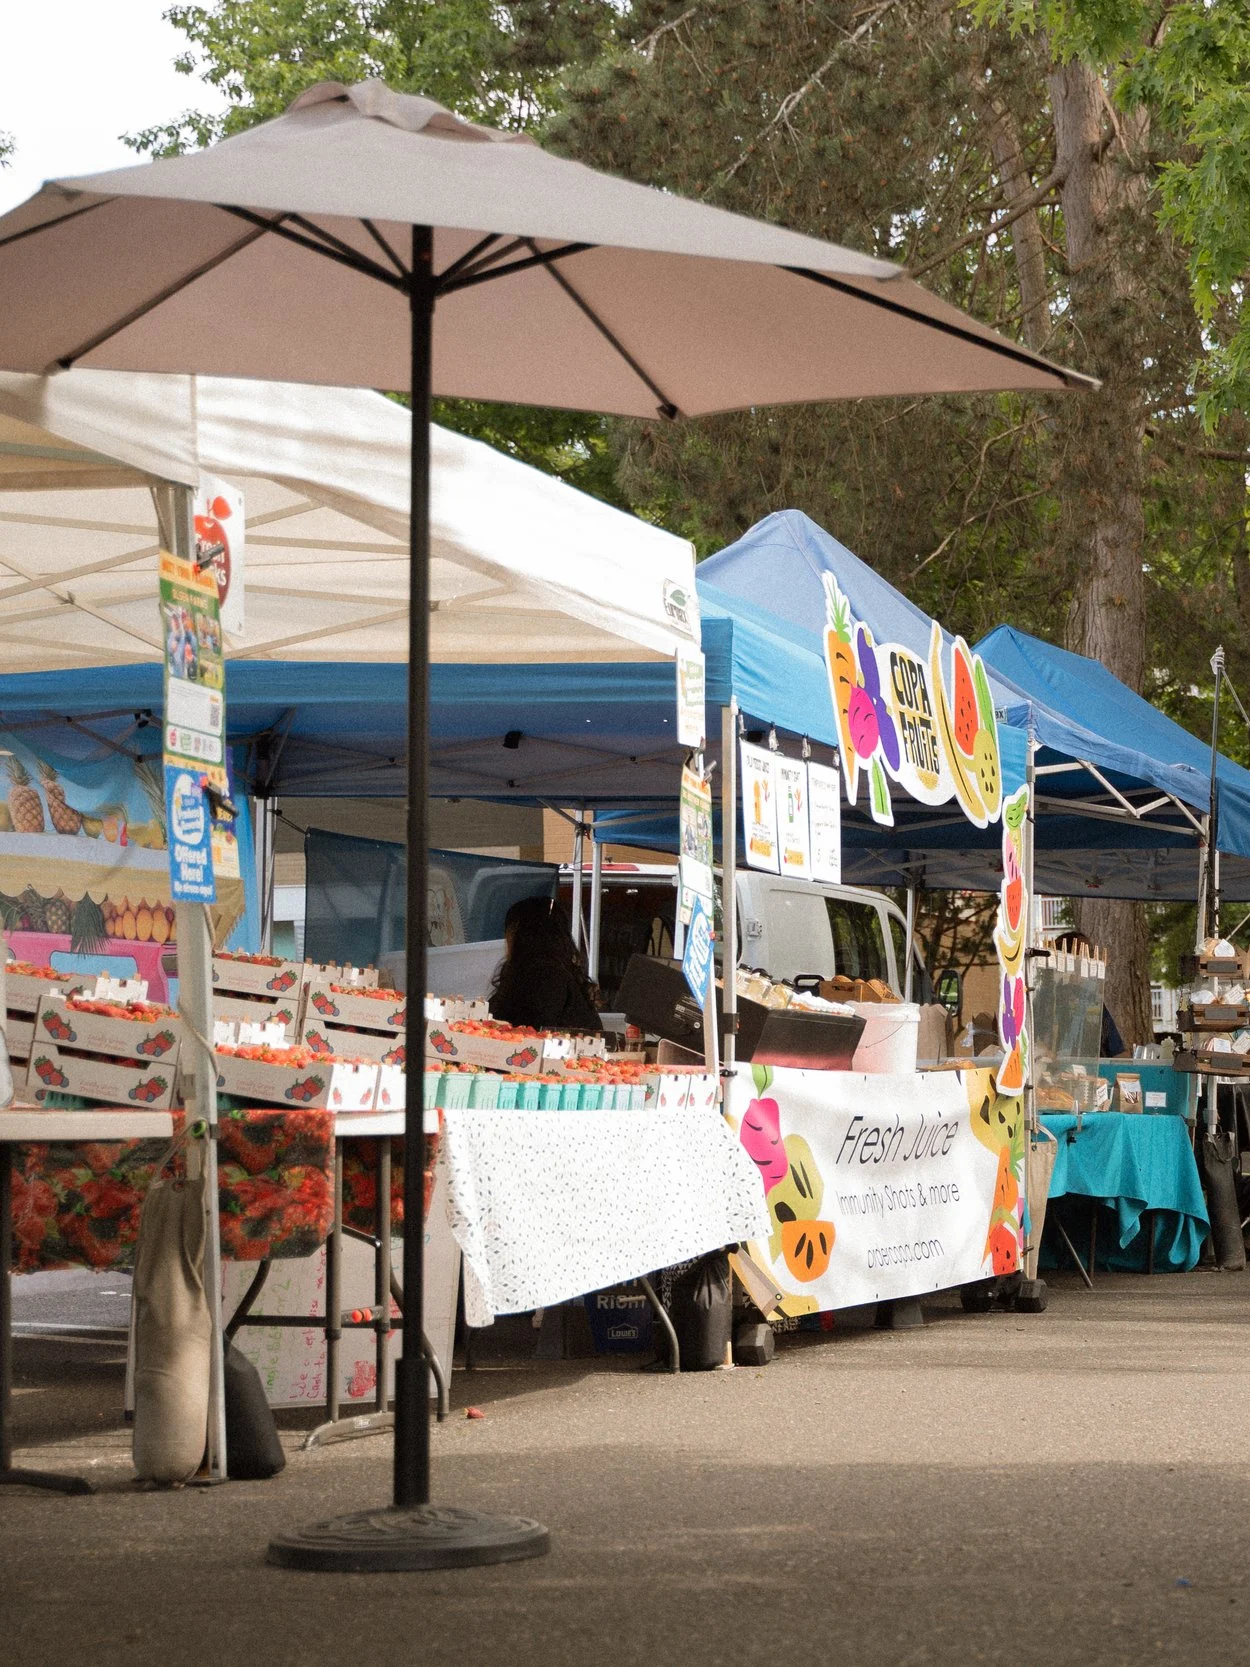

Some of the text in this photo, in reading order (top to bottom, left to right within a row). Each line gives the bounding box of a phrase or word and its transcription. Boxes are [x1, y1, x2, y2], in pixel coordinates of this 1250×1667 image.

[890, 651, 932, 717] COPA
[899, 710, 940, 775] FRUITS
[836, 1111, 959, 1164] Fresh Juice
[836, 1182, 961, 1219] Immunity Shots & more
[867, 1238, 946, 1269] ordercopa.com
